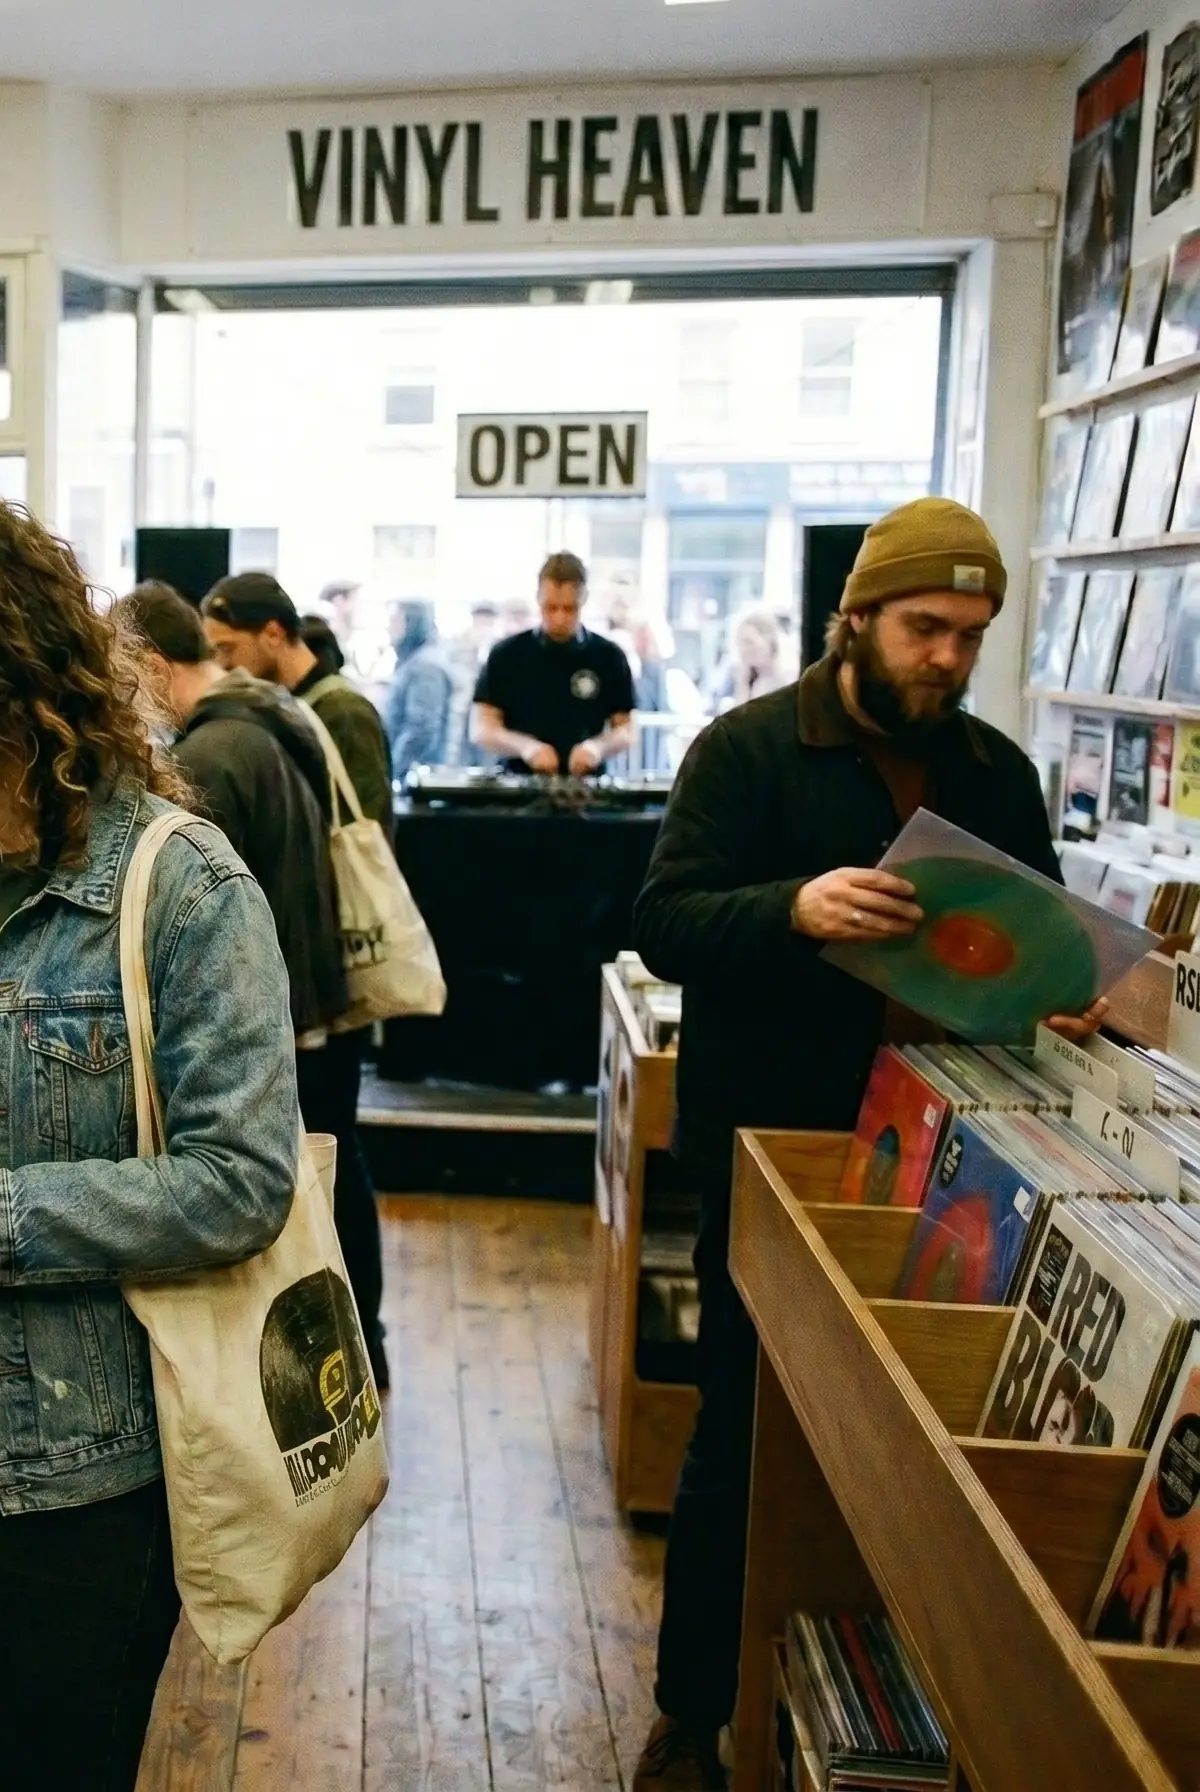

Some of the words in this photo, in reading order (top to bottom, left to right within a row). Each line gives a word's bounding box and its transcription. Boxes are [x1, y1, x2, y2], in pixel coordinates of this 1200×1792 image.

[288, 121, 500, 228] VINYL
[526, 108, 820, 222] HEAVEN
[469, 424, 637, 487] OPEN
[1050, 1252, 1126, 1383] RED
